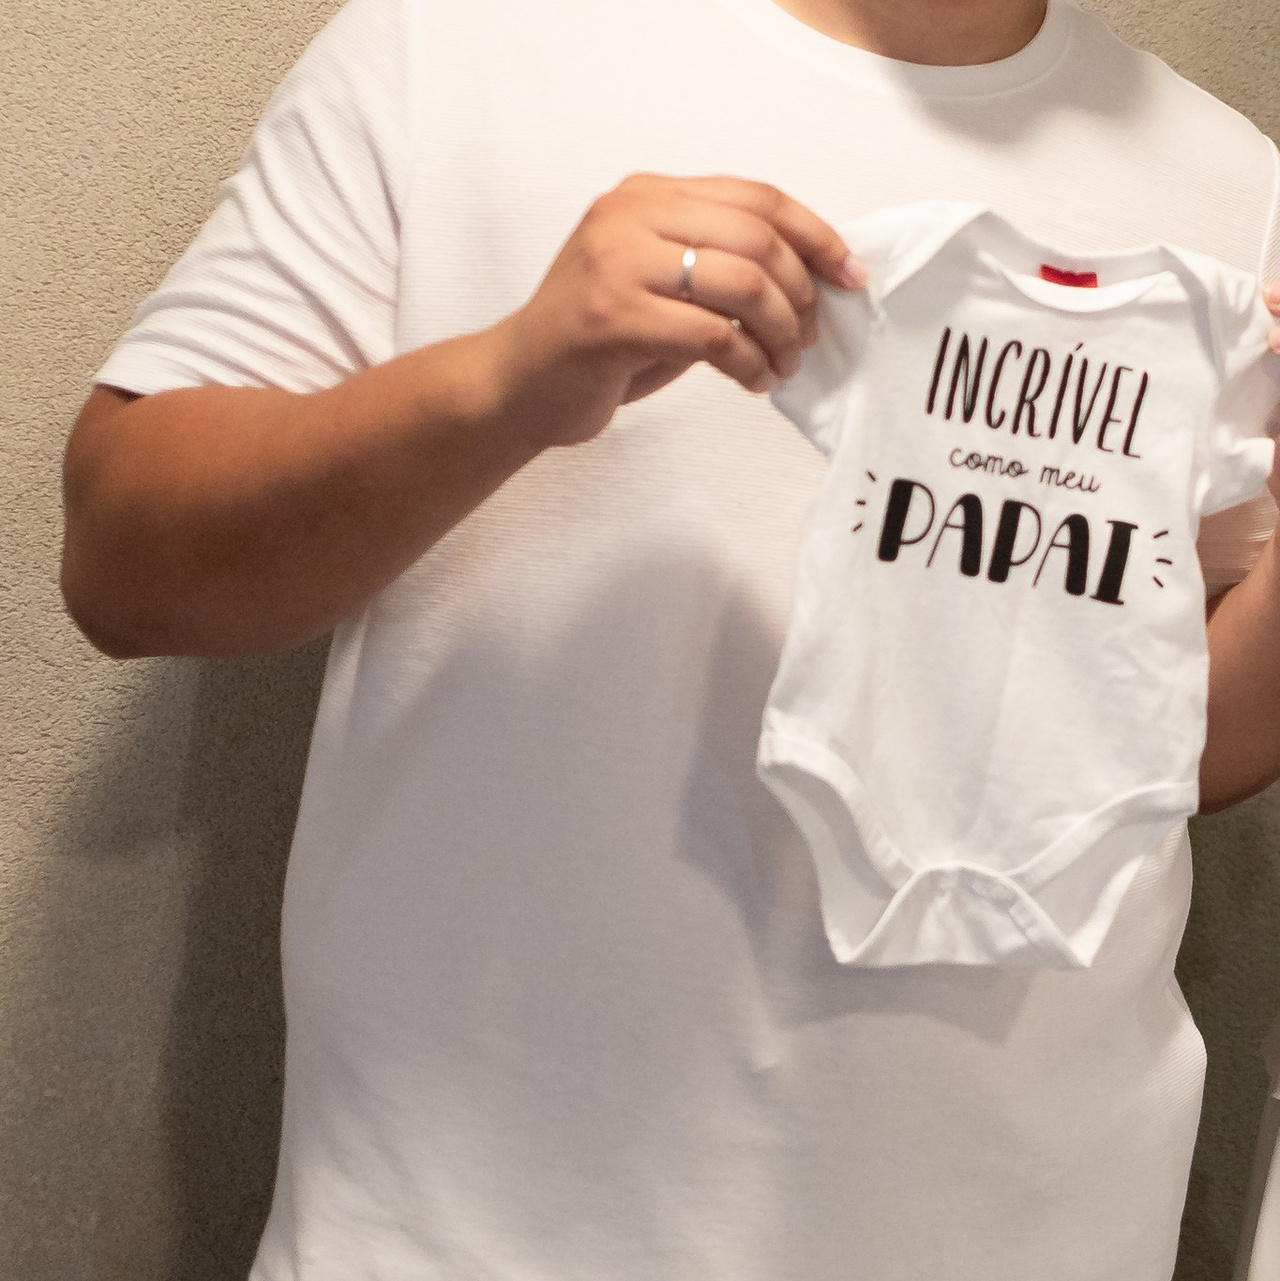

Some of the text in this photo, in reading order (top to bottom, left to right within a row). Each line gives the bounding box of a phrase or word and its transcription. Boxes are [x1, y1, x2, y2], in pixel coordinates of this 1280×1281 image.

[925, 326, 1150, 459] INCRÍVEL
[949, 446, 1102, 493] como meu
[876, 477, 1139, 606] PAPAI
